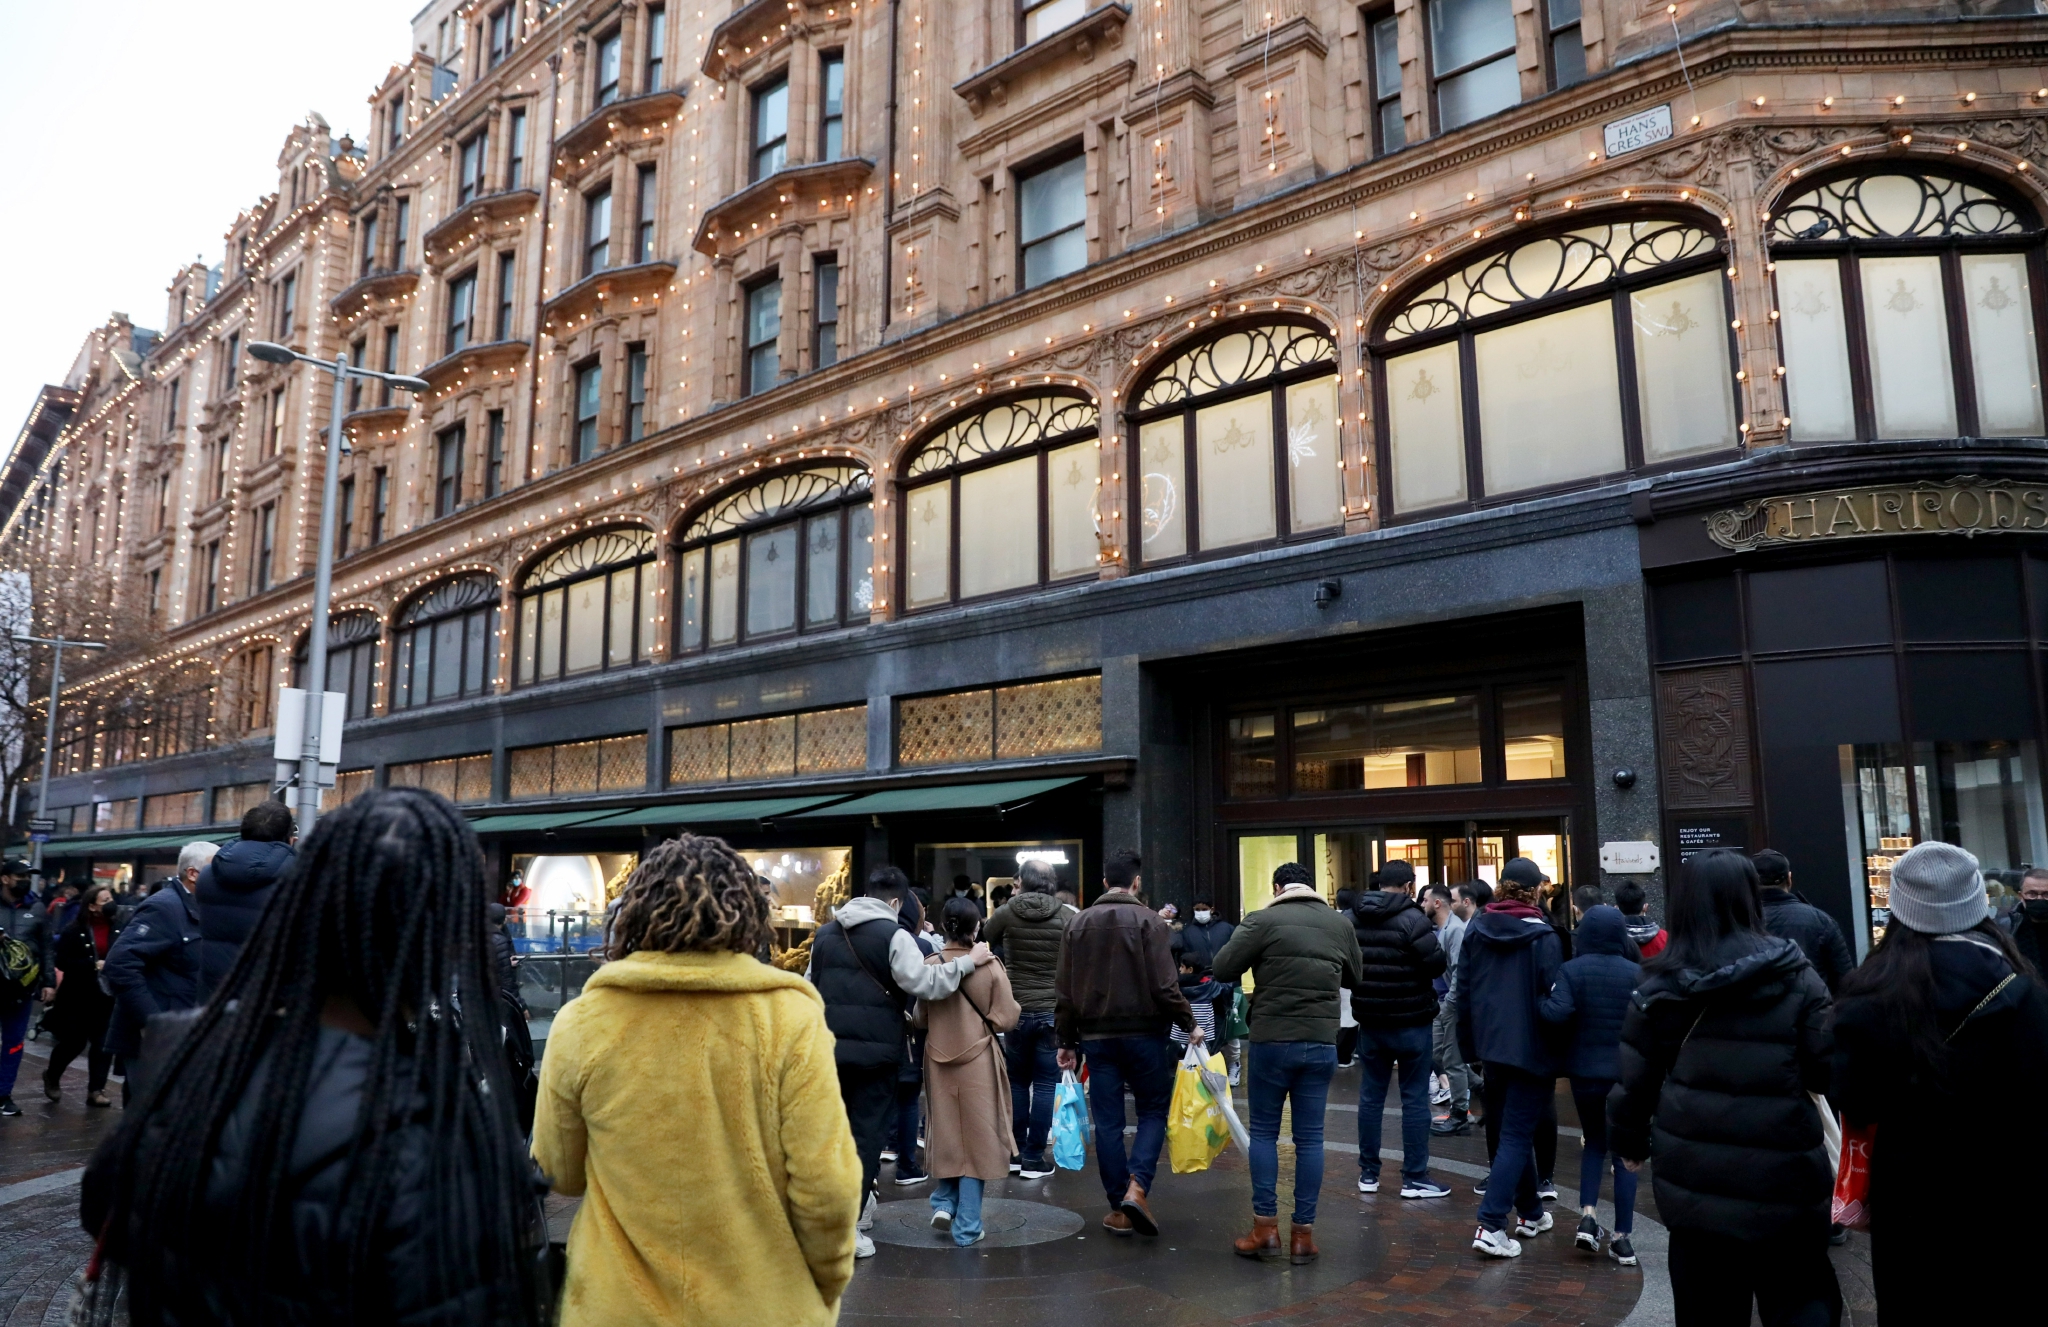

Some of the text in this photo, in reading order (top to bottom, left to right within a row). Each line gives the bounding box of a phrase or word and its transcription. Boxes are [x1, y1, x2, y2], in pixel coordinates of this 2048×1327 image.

[1619, 117, 1656, 138] HANS
[1778, 488, 2048, 537] HARRODS
[1612, 852, 1643, 864] Harrods
